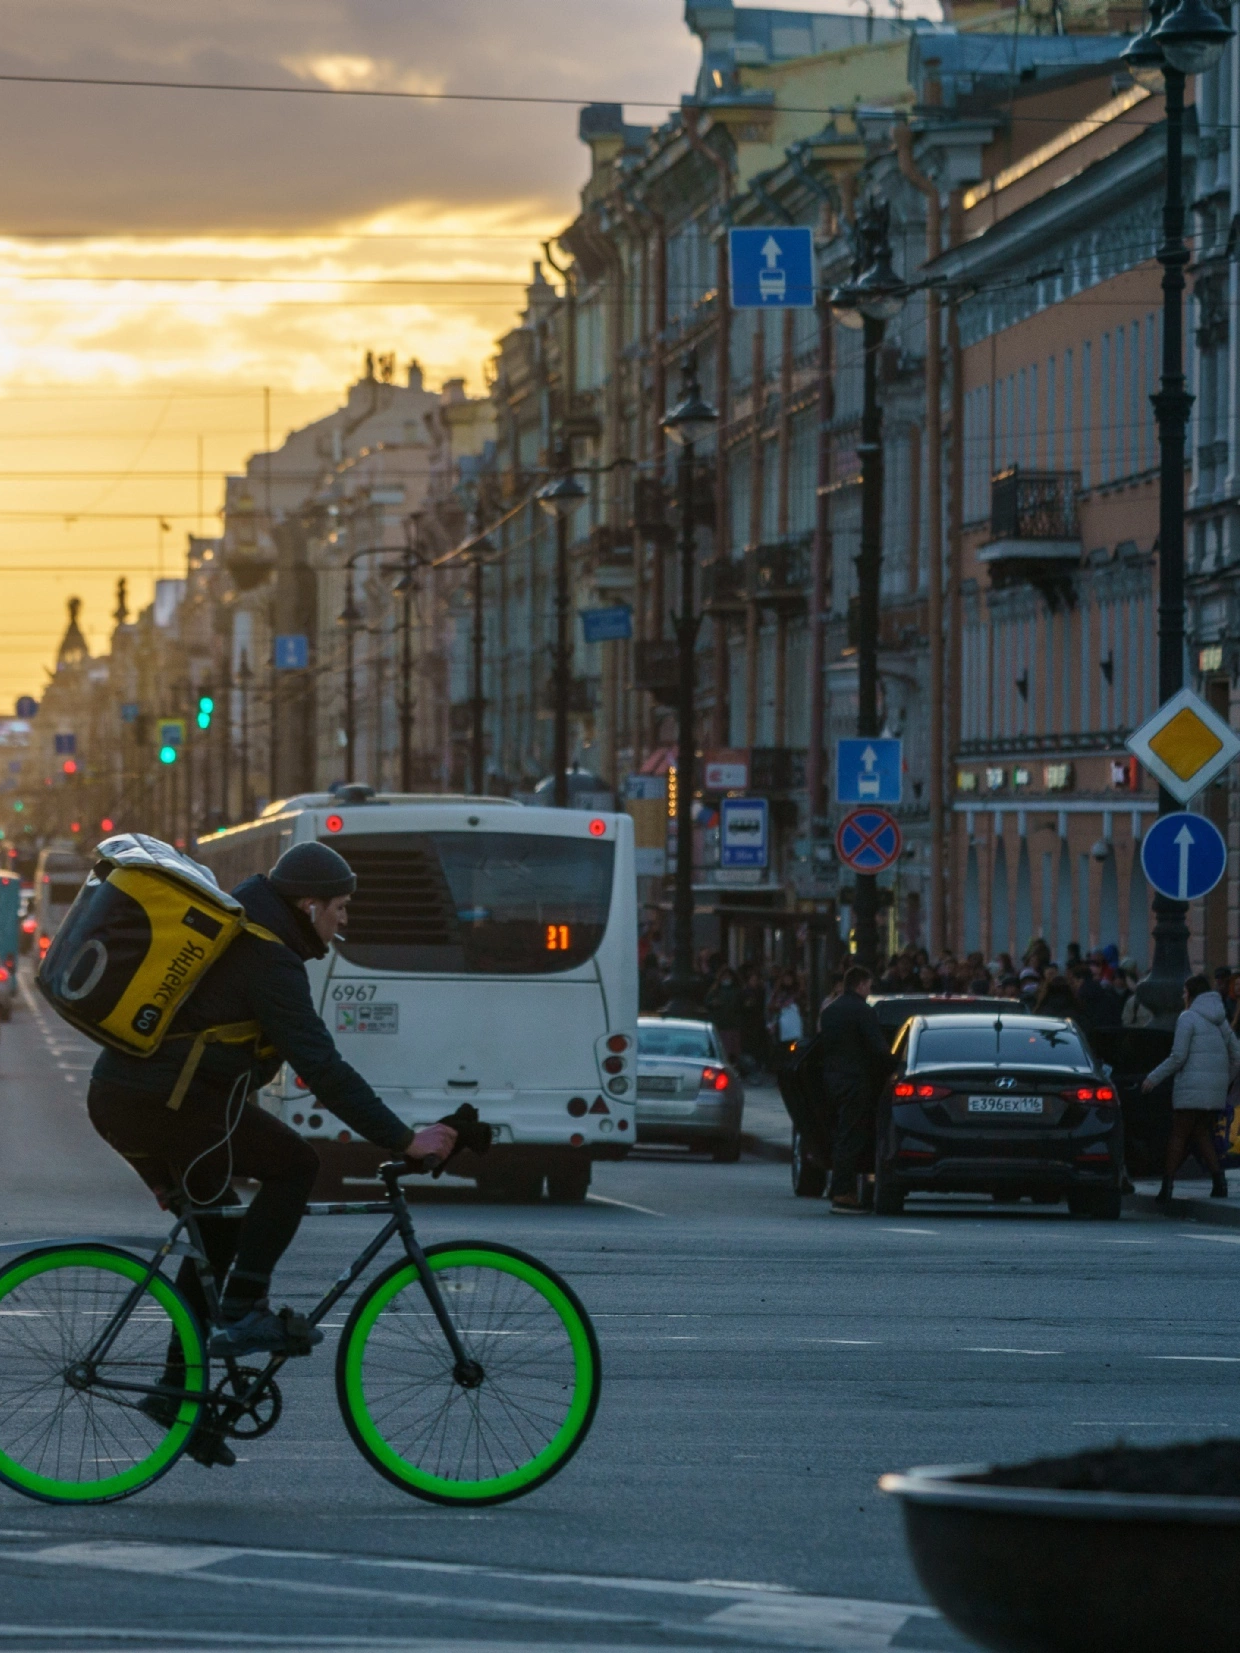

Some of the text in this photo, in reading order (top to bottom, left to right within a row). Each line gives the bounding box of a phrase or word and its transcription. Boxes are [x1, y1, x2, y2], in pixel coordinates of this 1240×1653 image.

[137, 940, 206, 1030] Яндекс Go
[332, 985, 377, 1001] 6967
